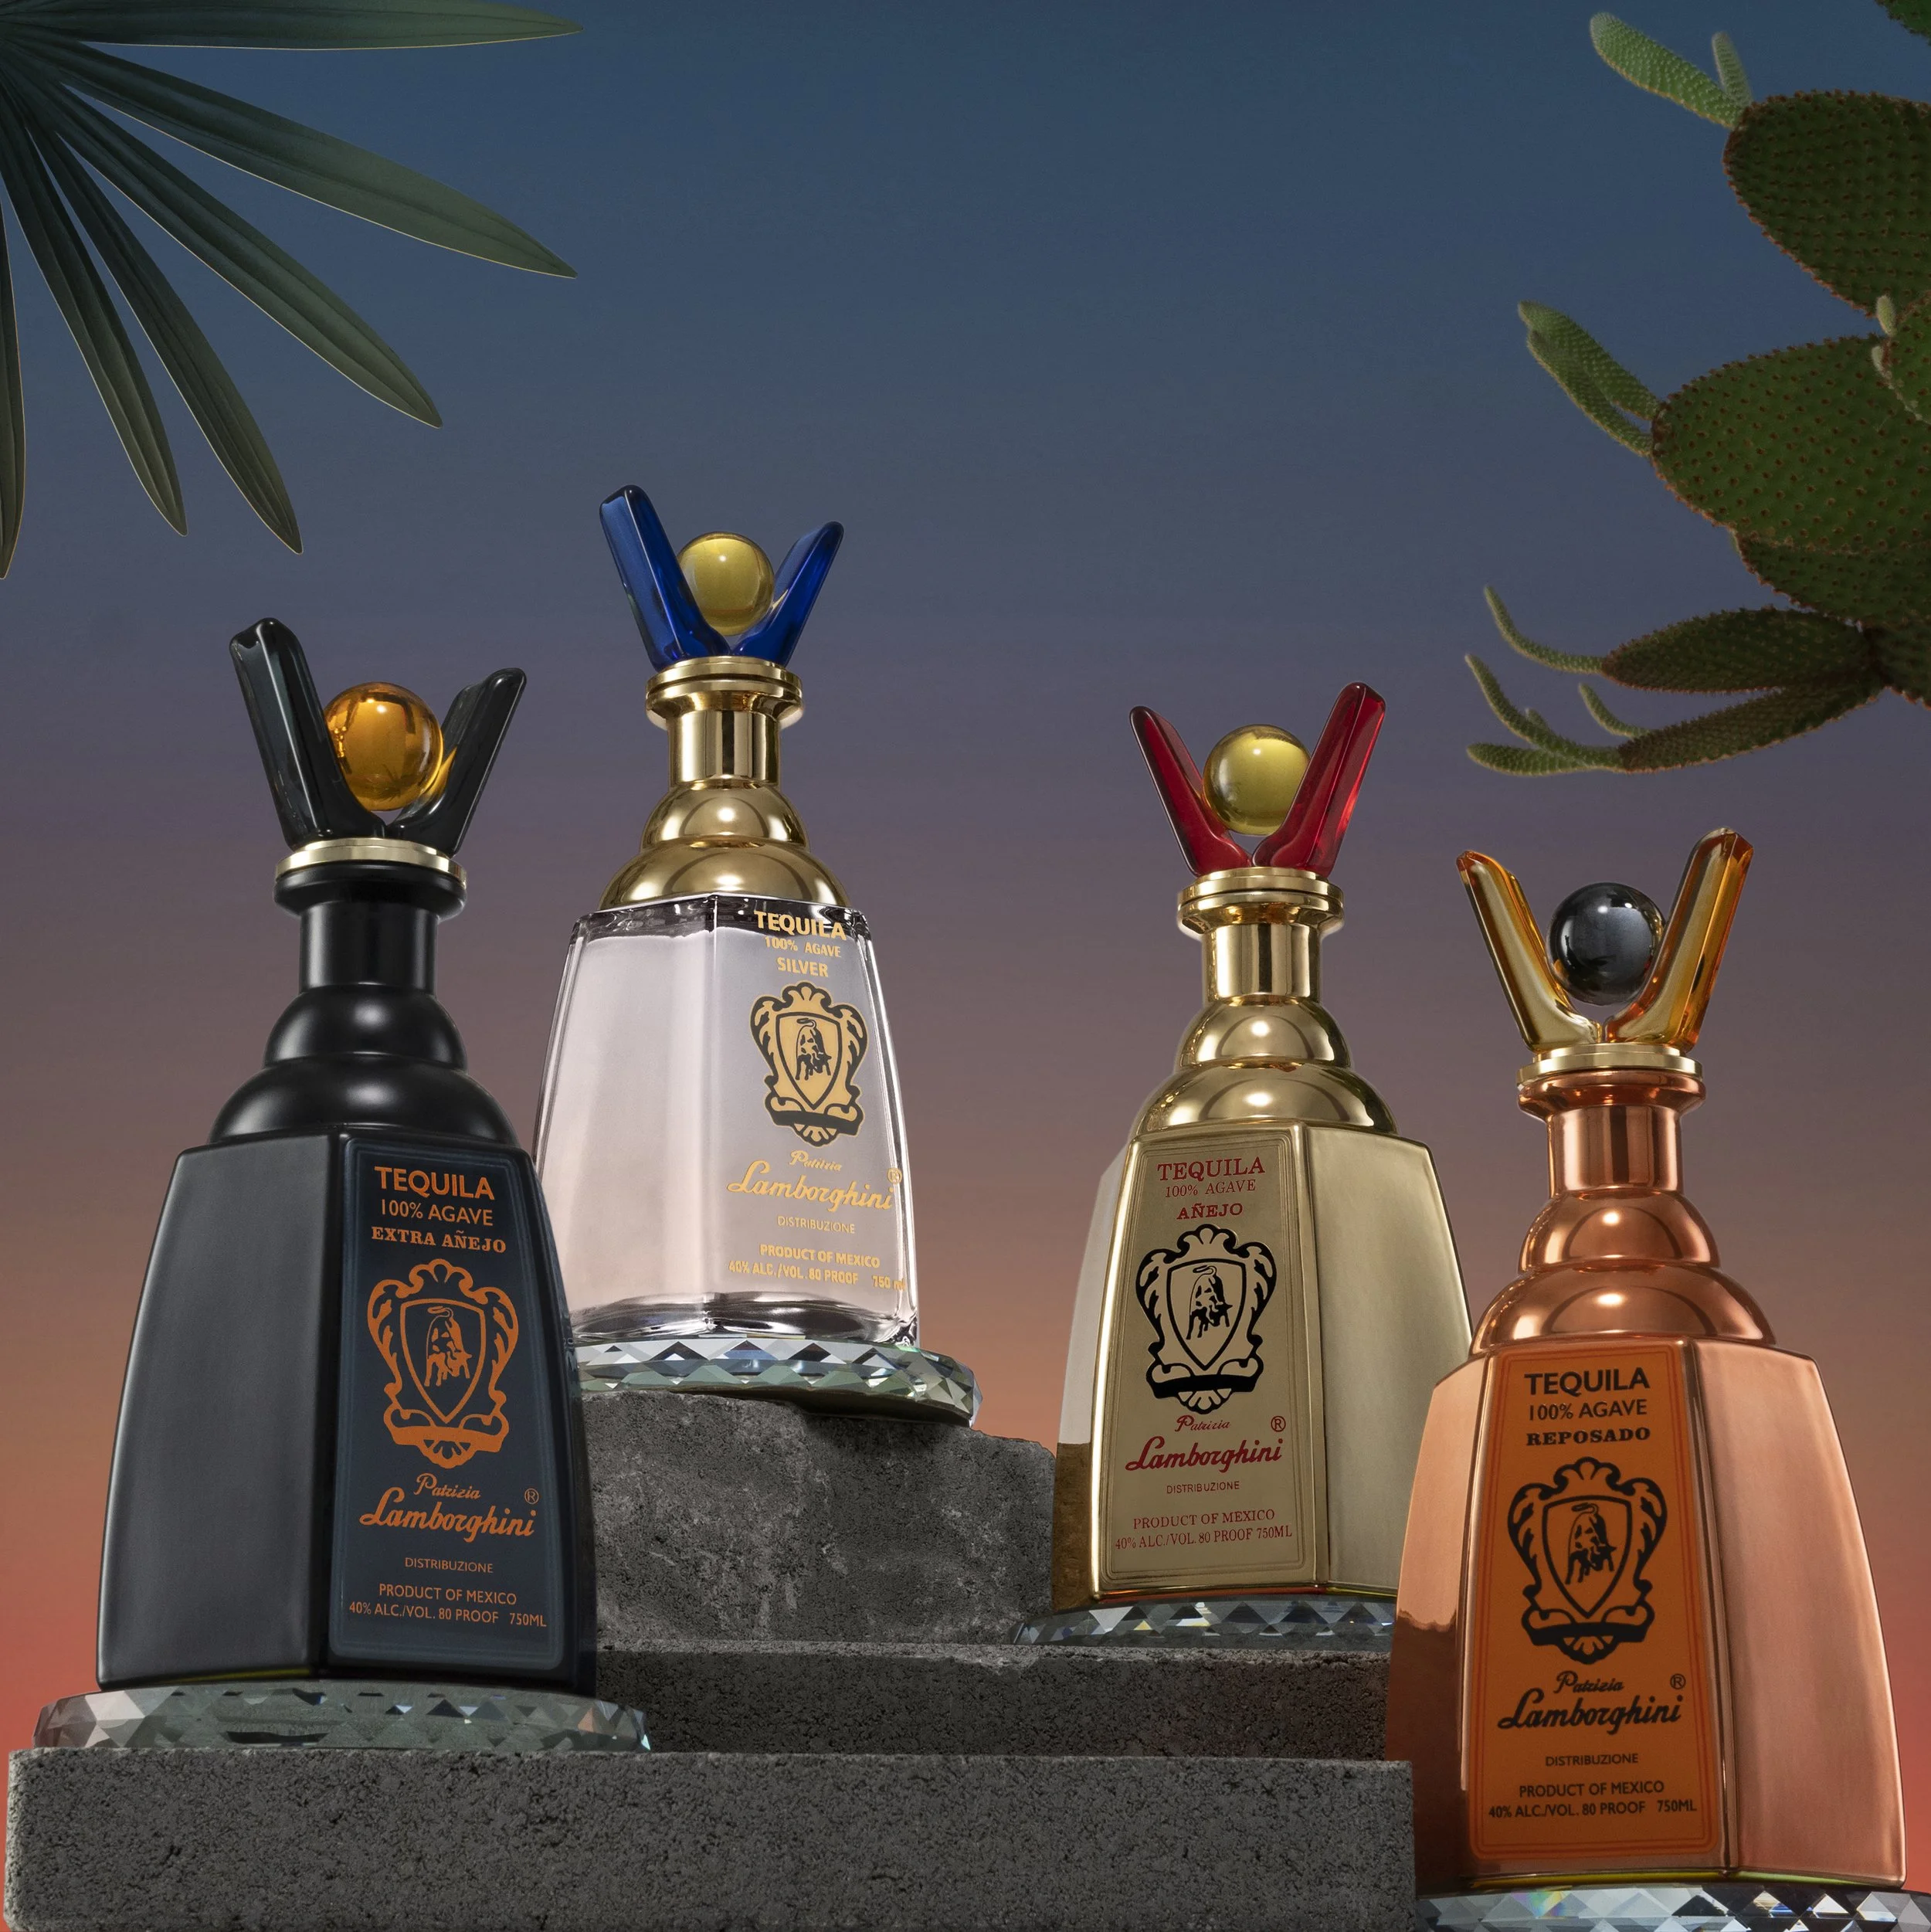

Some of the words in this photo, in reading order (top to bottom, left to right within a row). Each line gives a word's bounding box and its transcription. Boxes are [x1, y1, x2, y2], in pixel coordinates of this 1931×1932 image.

[754, 910, 847, 941] TEQUILA
[765, 936, 798, 952] 100%
[804, 942, 841, 958] AGAVE
[777, 957, 829, 977] SILVER
[1157, 1157, 1265, 1182] TEQUILA
[374, 1166, 494, 1200] TEQUILA
[727, 1160, 894, 1212] Lamborghini
[1165, 1184, 1197, 1197] 100%
[1205, 1180, 1256, 1194] AGAVE
[382, 1199, 423, 1219] 100%
[428, 1204, 494, 1226] AGAVE
[1176, 1203, 1243, 1220] AÑEJO
[777, 1216, 855, 1234] DISTRIBUZIONE
[372, 1226, 436, 1246] EXTRA
[442, 1231, 506, 1253] AÑEJO
[760, 1244, 813, 1261] PRODUCT
[818, 1251, 833, 1262] OF
[836, 1253, 881, 1268] MEXICO
[728, 1261, 750, 1274] 40%
[809, 1268, 821, 1281] 80
[823, 1270, 859, 1285] PROOF
[1524, 1367, 1650, 1397] TEQUILA
[1529, 1402, 1573, 1420] 100%
[1579, 1399, 1647, 1418] AGAVE
[1526, 1428, 1651, 1446] REPOSADO
[1125, 1436, 1283, 1472] Lamborghini
[414, 1472, 480, 1499] Patrizia
[1166, 1481, 1240, 1494] DISTRIBUZIONE
[360, 1486, 536, 1542] Lamborghini
[1133, 1514, 1197, 1530] PRODUCT
[1200, 1513, 1218, 1525] OF
[1223, 1509, 1274, 1523] MEXICO
[1115, 1537, 1135, 1550] 40%
[1199, 1533, 1211, 1543] 80
[1213, 1528, 1253, 1542] PROOF
[1257, 1525, 1293, 1539] 750ML
[405, 1557, 494, 1573] DISTRIBUZIONE
[379, 1584, 442, 1600] PRODUCT
[446, 1588, 463, 1601] OF
[467, 1590, 516, 1605] MEXICO
[349, 1601, 371, 1615] 40%
[439, 1608, 451, 1620] 80
[456, 1610, 499, 1623] PROOF
[510, 1613, 547, 1627] 750ML
[1553, 1670, 1625, 1693] Patrizia
[1497, 1688, 1684, 1735] Lamborghini
[1546, 1754, 1638, 1766] DISTRIBUZIONE
[1519, 1783, 1584, 1798] PRODUCT
[1588, 1783, 1607, 1795] OF
[1611, 1780, 1665, 1794] MEXICO
[1488, 1805, 1512, 1818] 40%
[1582, 1803, 1596, 1815] 80
[1600, 1801, 1646, 1815] PROOF
[1658, 1799, 1698, 1812] 750ML
